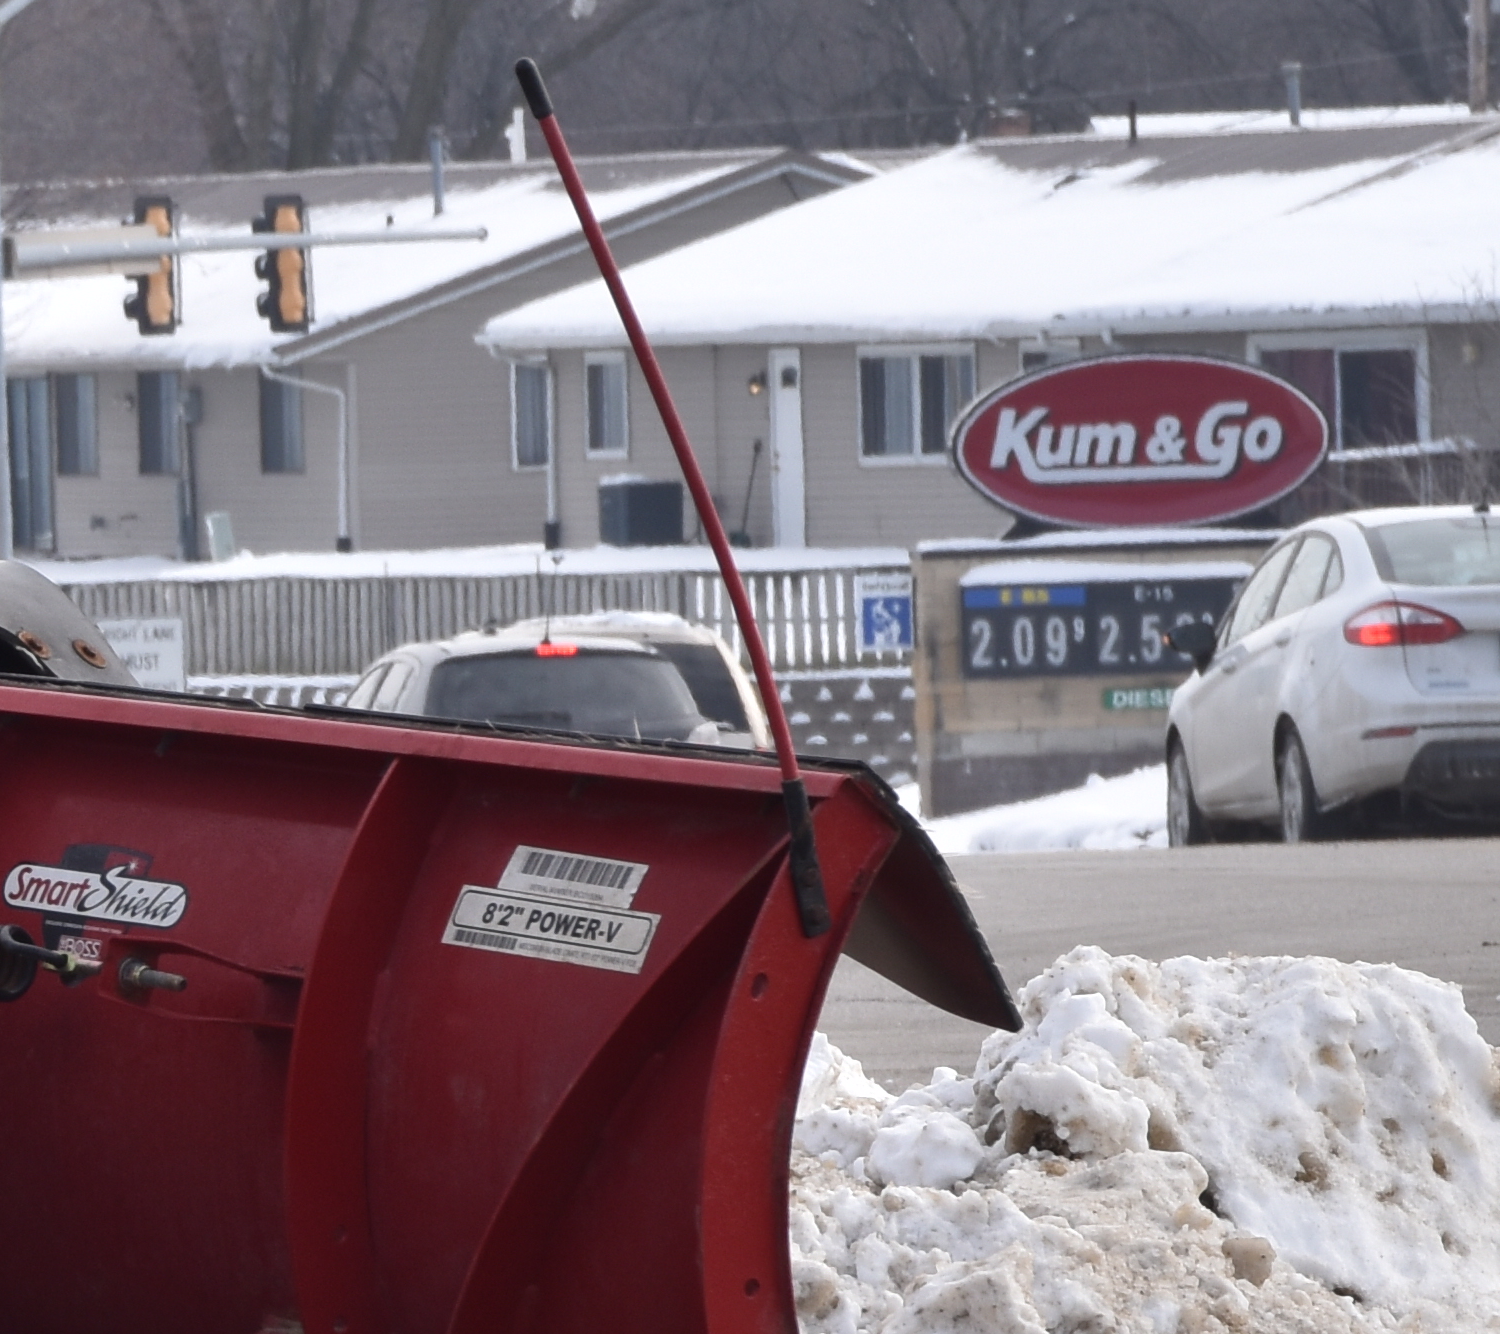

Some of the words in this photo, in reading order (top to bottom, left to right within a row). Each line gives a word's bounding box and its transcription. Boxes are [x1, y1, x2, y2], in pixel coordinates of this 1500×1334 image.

[990, 406, 1138, 473] Kum
[1145, 414, 1187, 464] &
[1195, 401, 1283, 479] Go
[524, 909, 624, 943] POWER-V
[65, 937, 101, 958] BOSS
